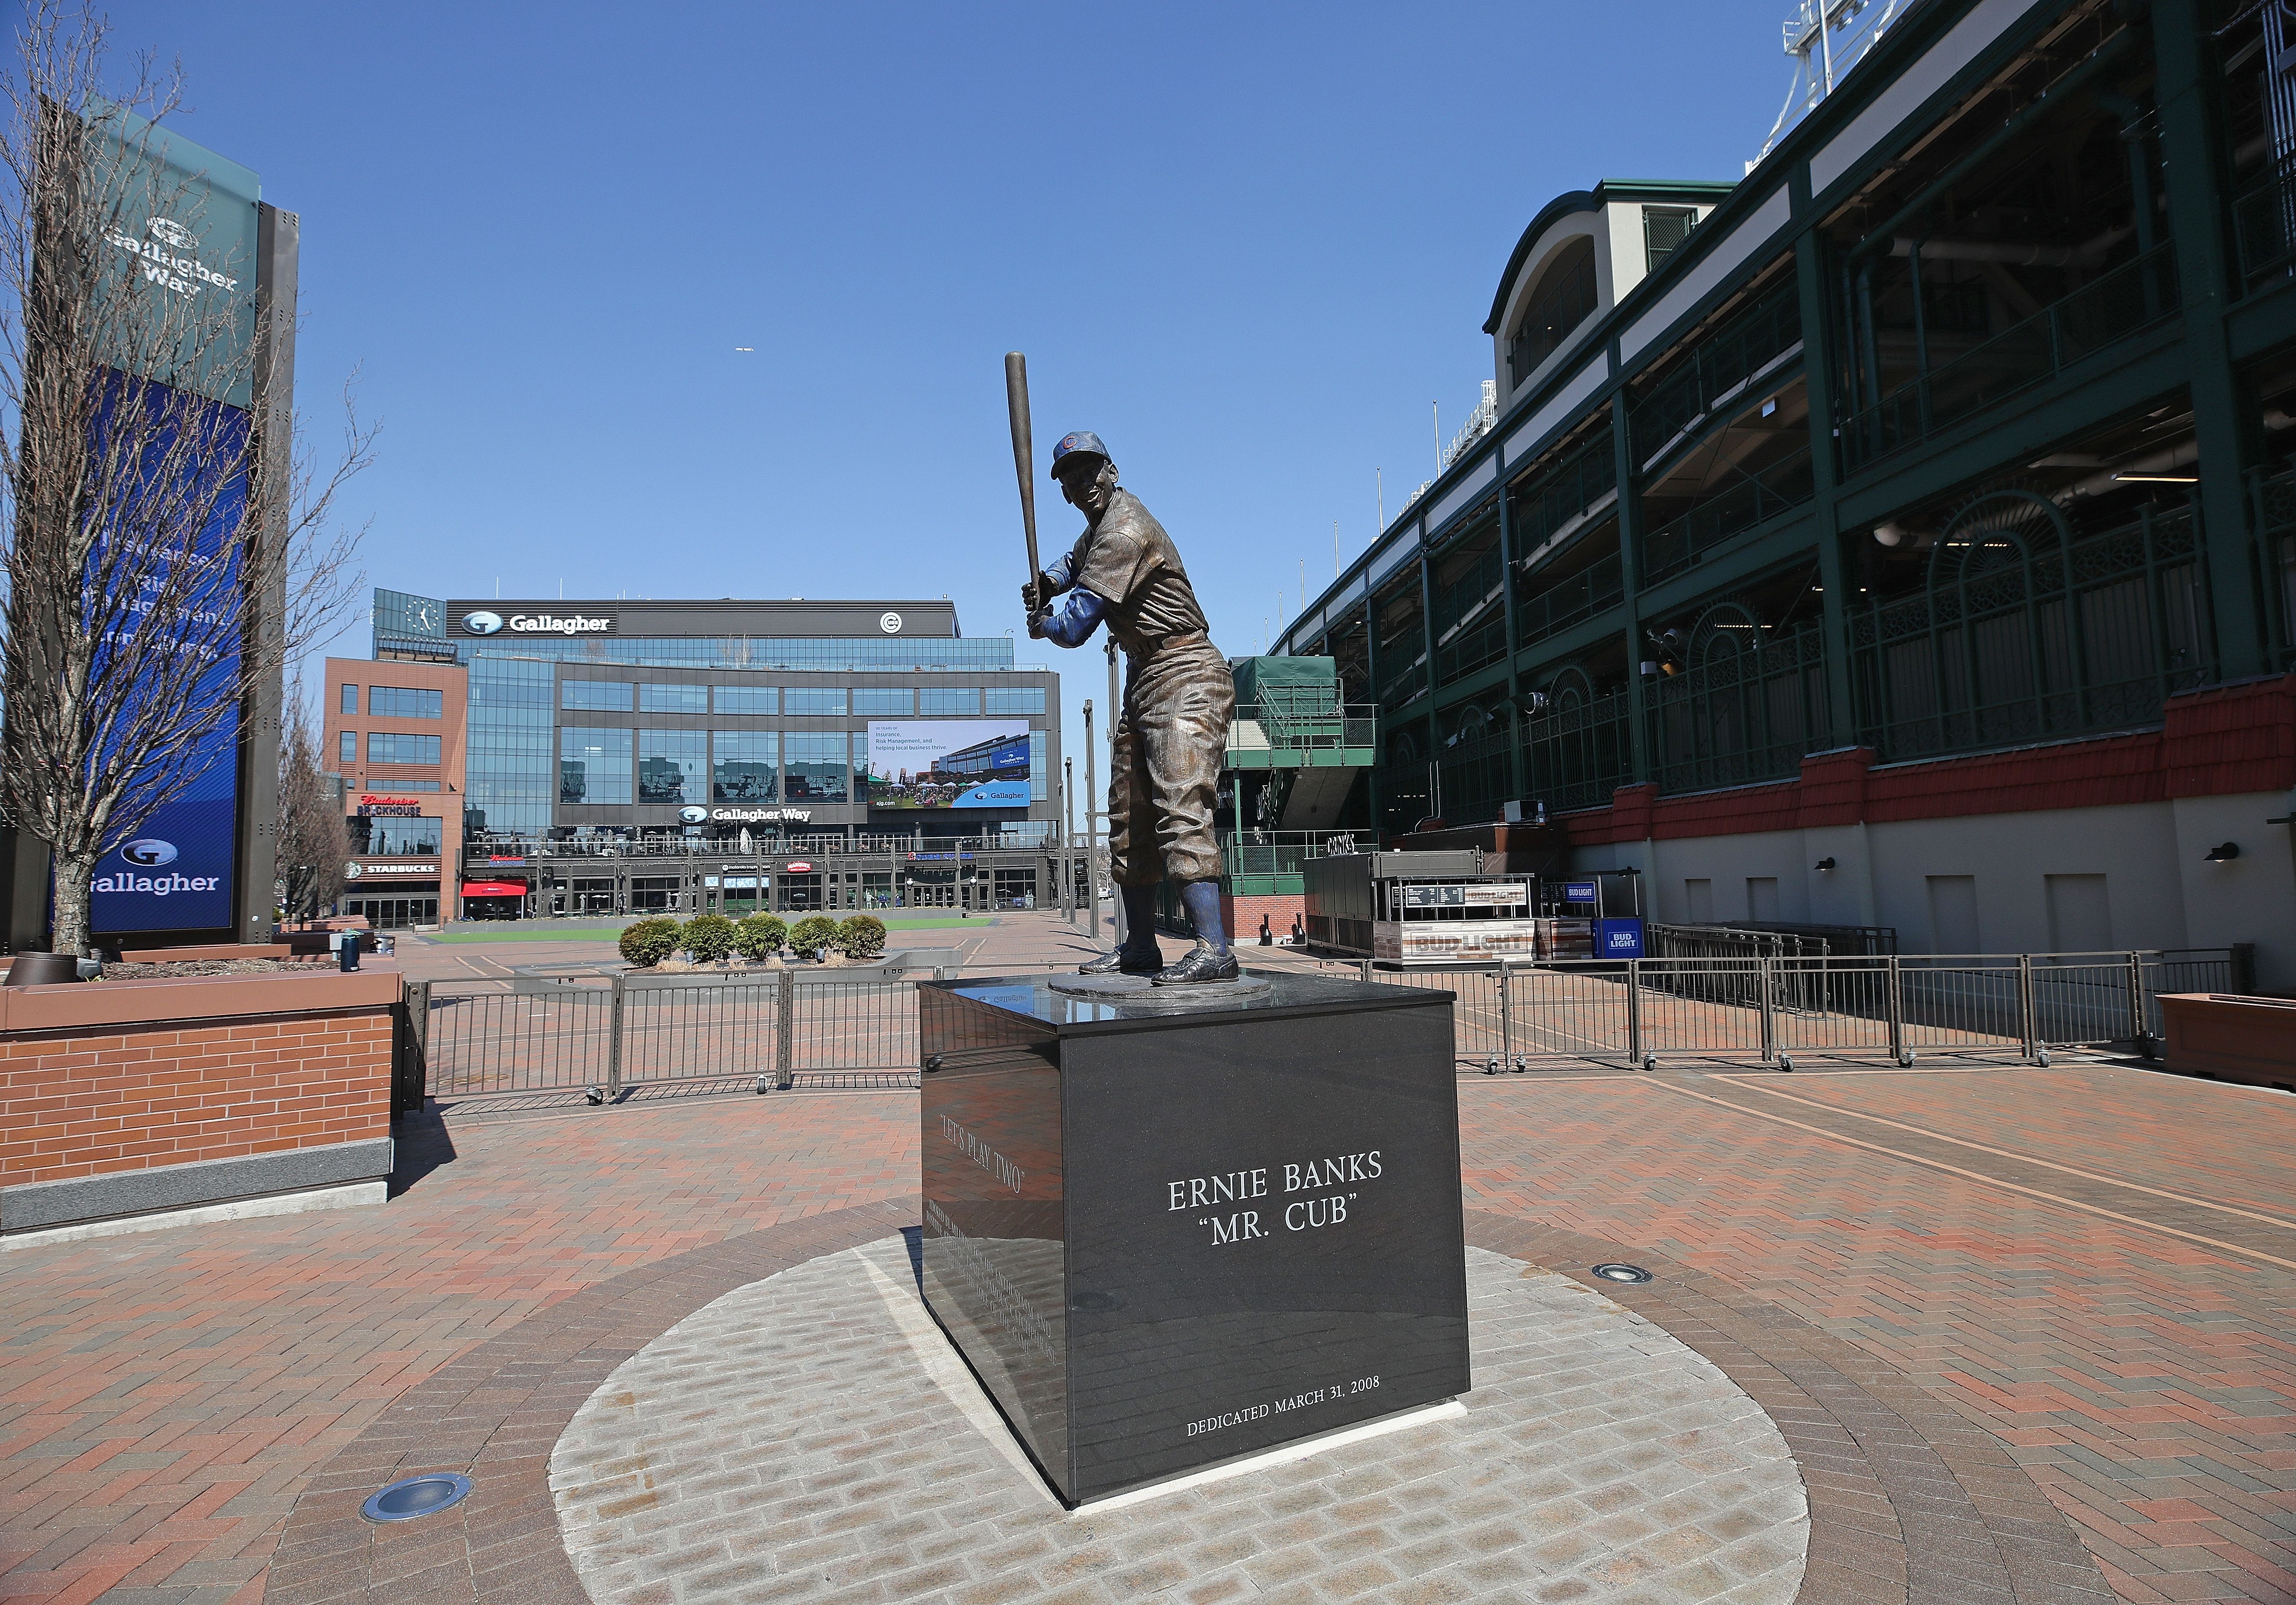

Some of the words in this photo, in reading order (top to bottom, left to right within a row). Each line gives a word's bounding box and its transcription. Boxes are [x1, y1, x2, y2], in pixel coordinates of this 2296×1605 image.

[1063, 436, 1077, 449] C
[509, 615, 610, 635] Gallagher
[360, 795, 418, 805] Budweiser
[712, 809, 780, 822] Gallagher
[781, 809, 811, 822] Way
[1471, 891, 1493, 900] BUD
[1415, 934, 1461, 952] BUD
[1462, 934, 1523, 950] LIGHT
[968, 1132, 991, 1171] PLAY
[994, 1151, 1025, 1194] TWO”
[1168, 1168, 1268, 1211] ERNIE
[1283, 1151, 1382, 1192] BANKS
[1199, 1210, 1269, 1246] “MR.
[1285, 1192, 1357, 1231] CUB”
[929, 1198, 944, 1222] ADORED
[985, 1257, 994, 1276] HIS
[995, 1269, 1034, 1319] ENTHUSIASM
[1036, 1312, 1051, 1338] AND
[986, 1277, 1008, 1311] FAMOUS
[1010, 1303, 1057, 1367] CATCHPHRASE
[1187, 1404, 1269, 1436] DEDICATED
[1275, 1389, 1324, 1414] MARCH
[1330, 1385, 1345, 1399] 31,
[1351, 1375, 1380, 1394] 2008
